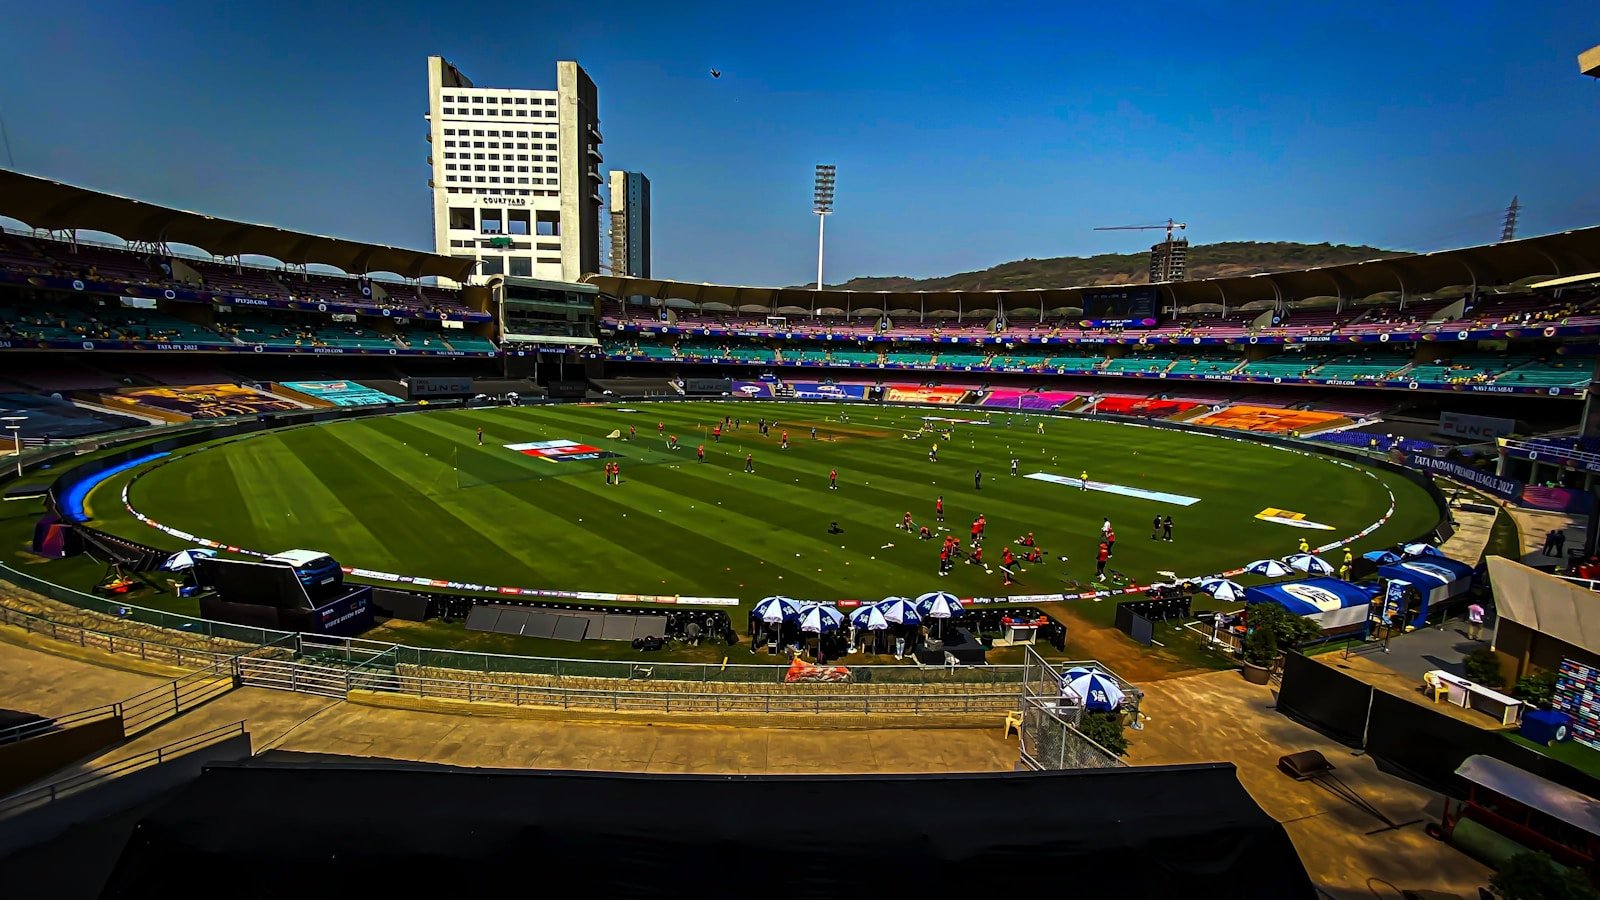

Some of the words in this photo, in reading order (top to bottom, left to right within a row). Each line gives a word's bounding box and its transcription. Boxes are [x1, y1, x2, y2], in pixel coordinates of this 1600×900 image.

[483, 197, 526, 205] COURTYARD
[1414, 455, 1430, 467] TATA
[1431, 459, 1454, 472] INDIAN
[1453, 464, 1476, 481] PREMIER
[1475, 471, 1498, 489] LEAGUE
[1497, 480, 1514, 494] 2022
